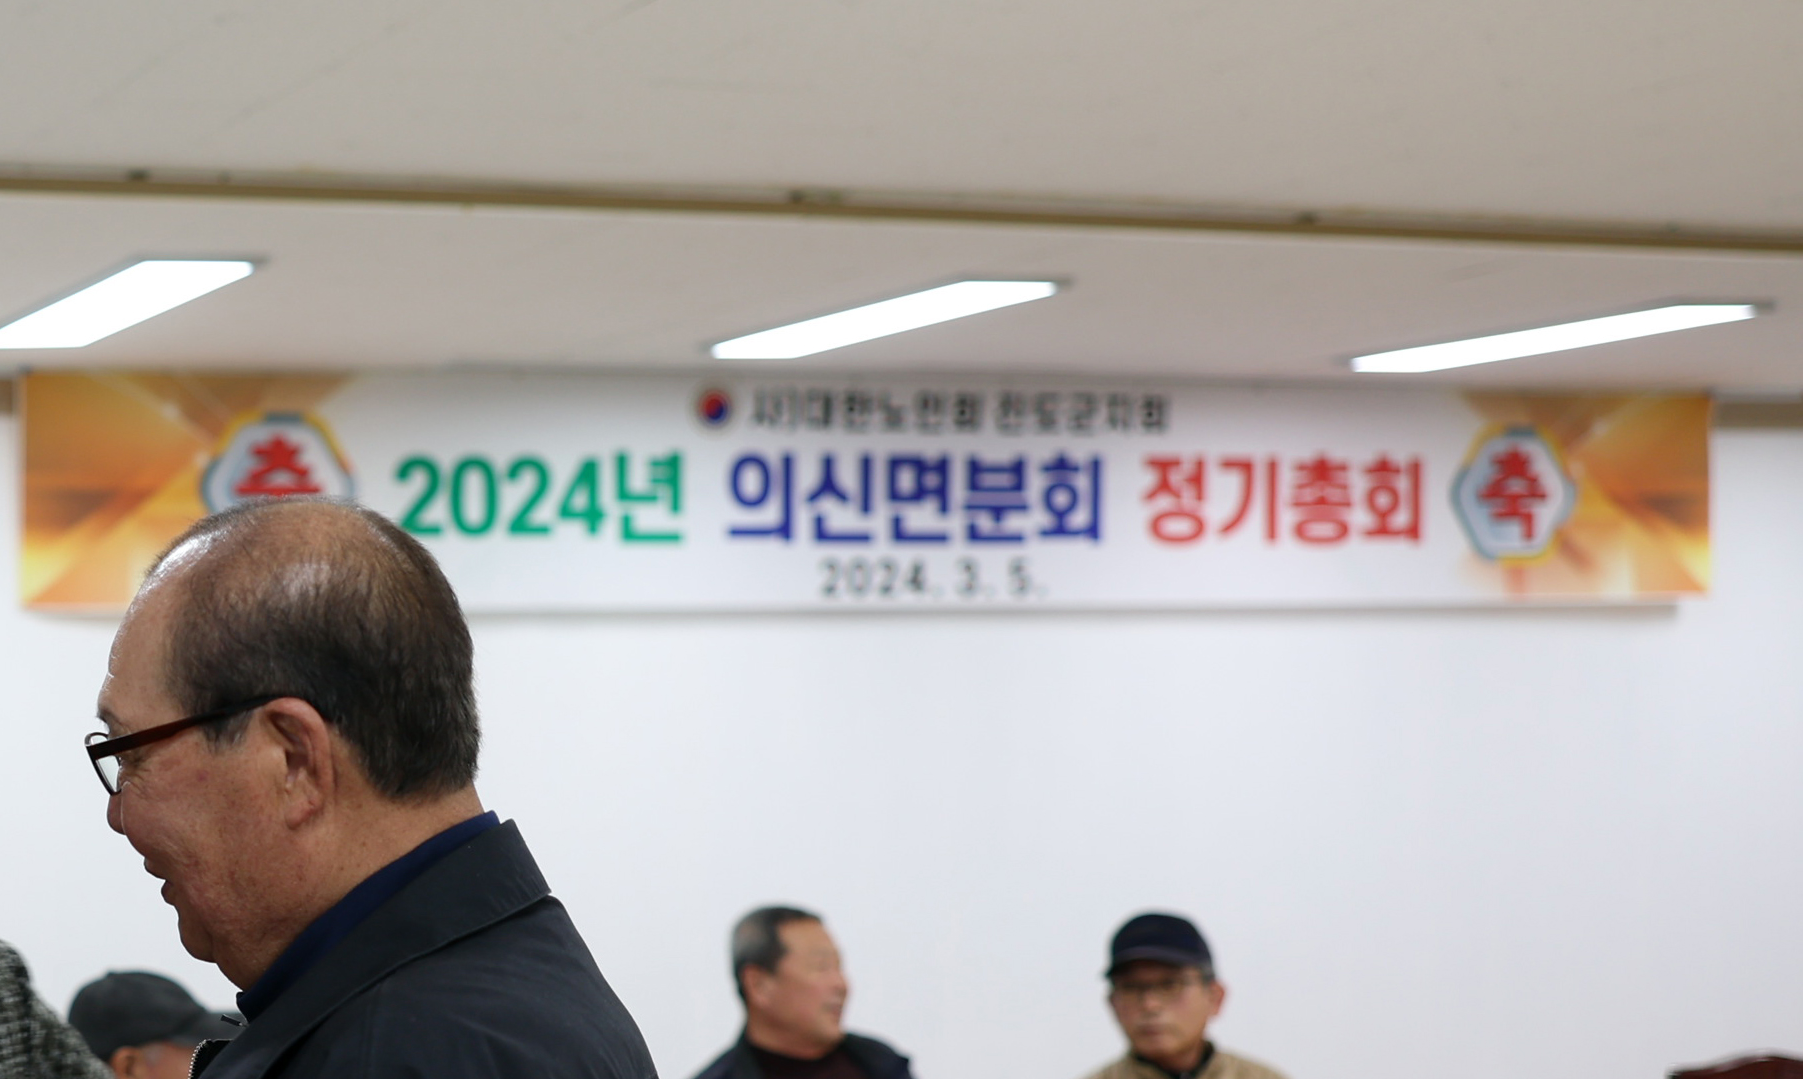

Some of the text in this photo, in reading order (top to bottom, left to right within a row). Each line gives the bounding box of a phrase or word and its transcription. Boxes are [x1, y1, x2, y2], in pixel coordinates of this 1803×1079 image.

[395, 450, 1427, 547] 2024년 의신면분회 정기총회
[1478, 446, 1549, 541] 축
